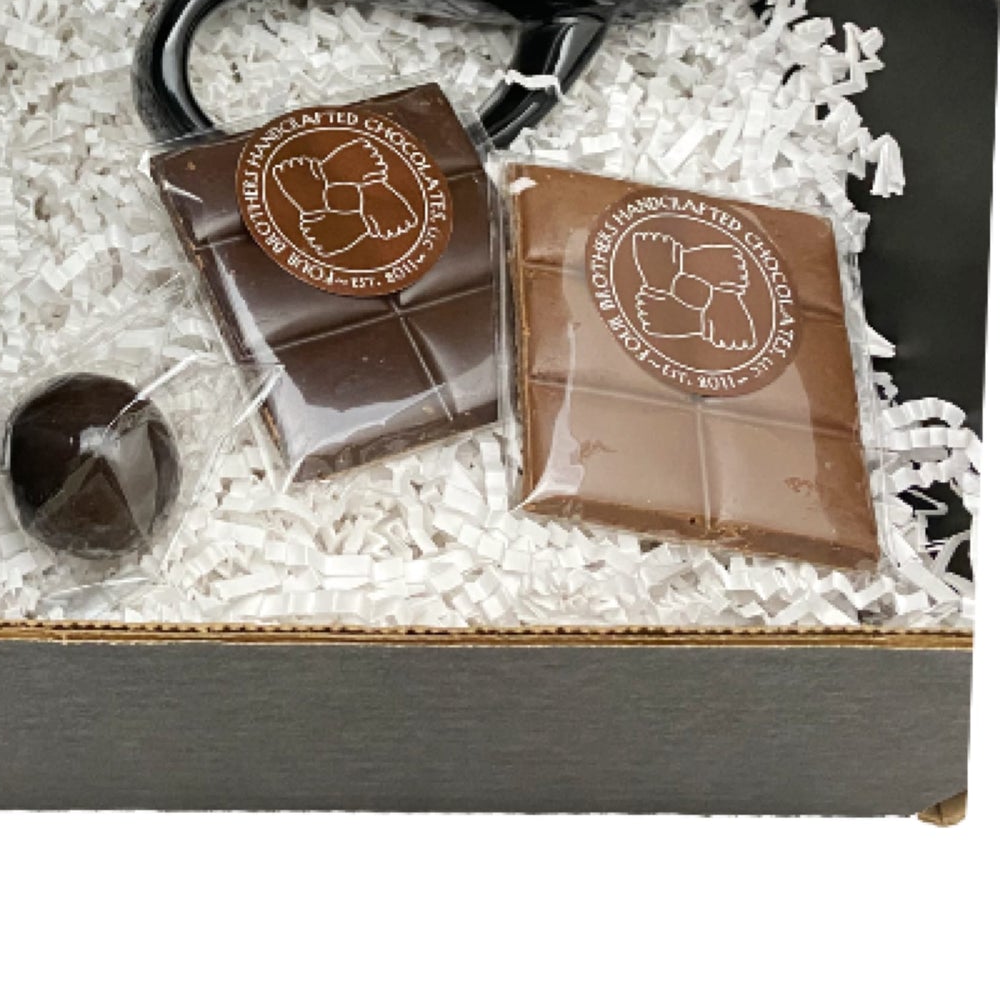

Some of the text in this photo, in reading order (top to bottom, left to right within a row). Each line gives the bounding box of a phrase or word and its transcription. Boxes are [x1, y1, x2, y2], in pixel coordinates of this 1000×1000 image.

[247, 111, 359, 286] FOUR HANDCRAFTED
[612, 195, 742, 232] HANDCRAFTED
